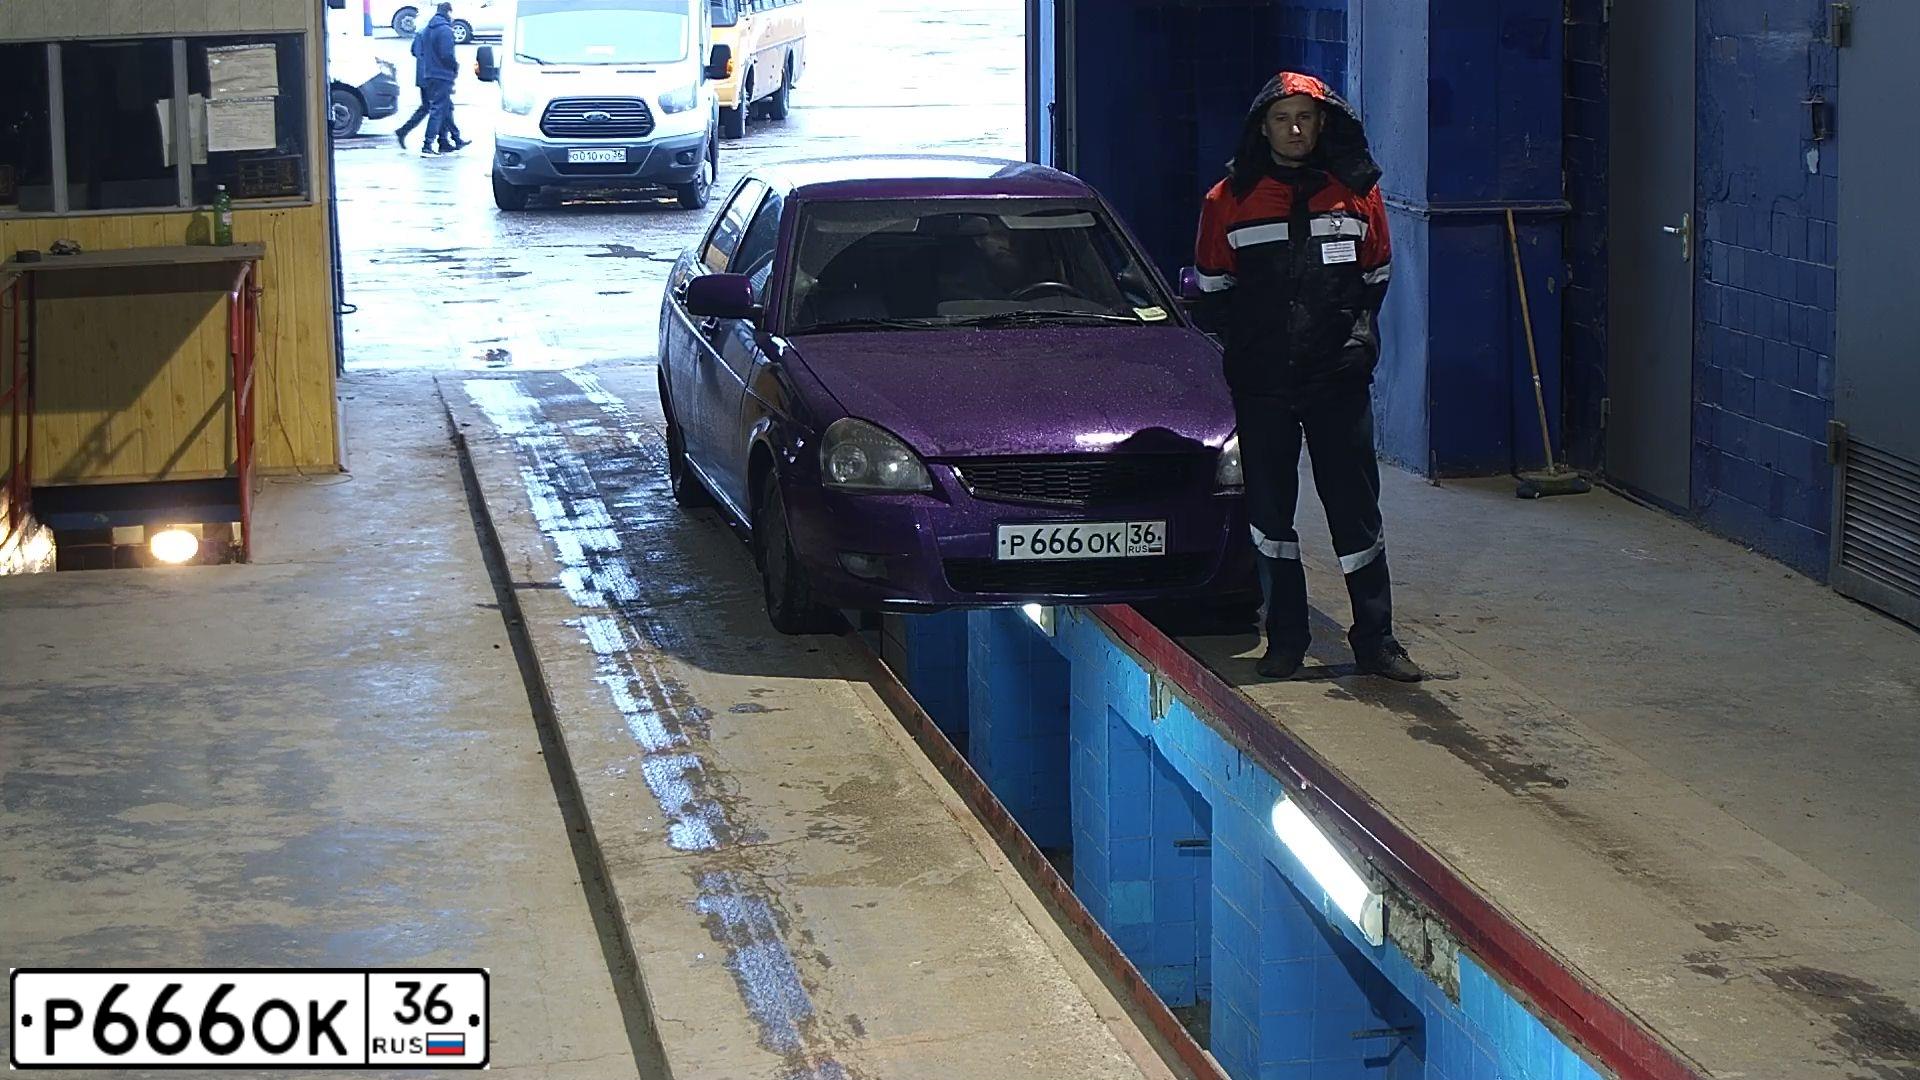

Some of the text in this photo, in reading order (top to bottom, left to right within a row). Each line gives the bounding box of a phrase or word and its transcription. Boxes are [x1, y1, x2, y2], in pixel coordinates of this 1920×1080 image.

[1010, 524, 1156, 556] Р666ОК 36
[1128, 545, 1148, 554] RUS
